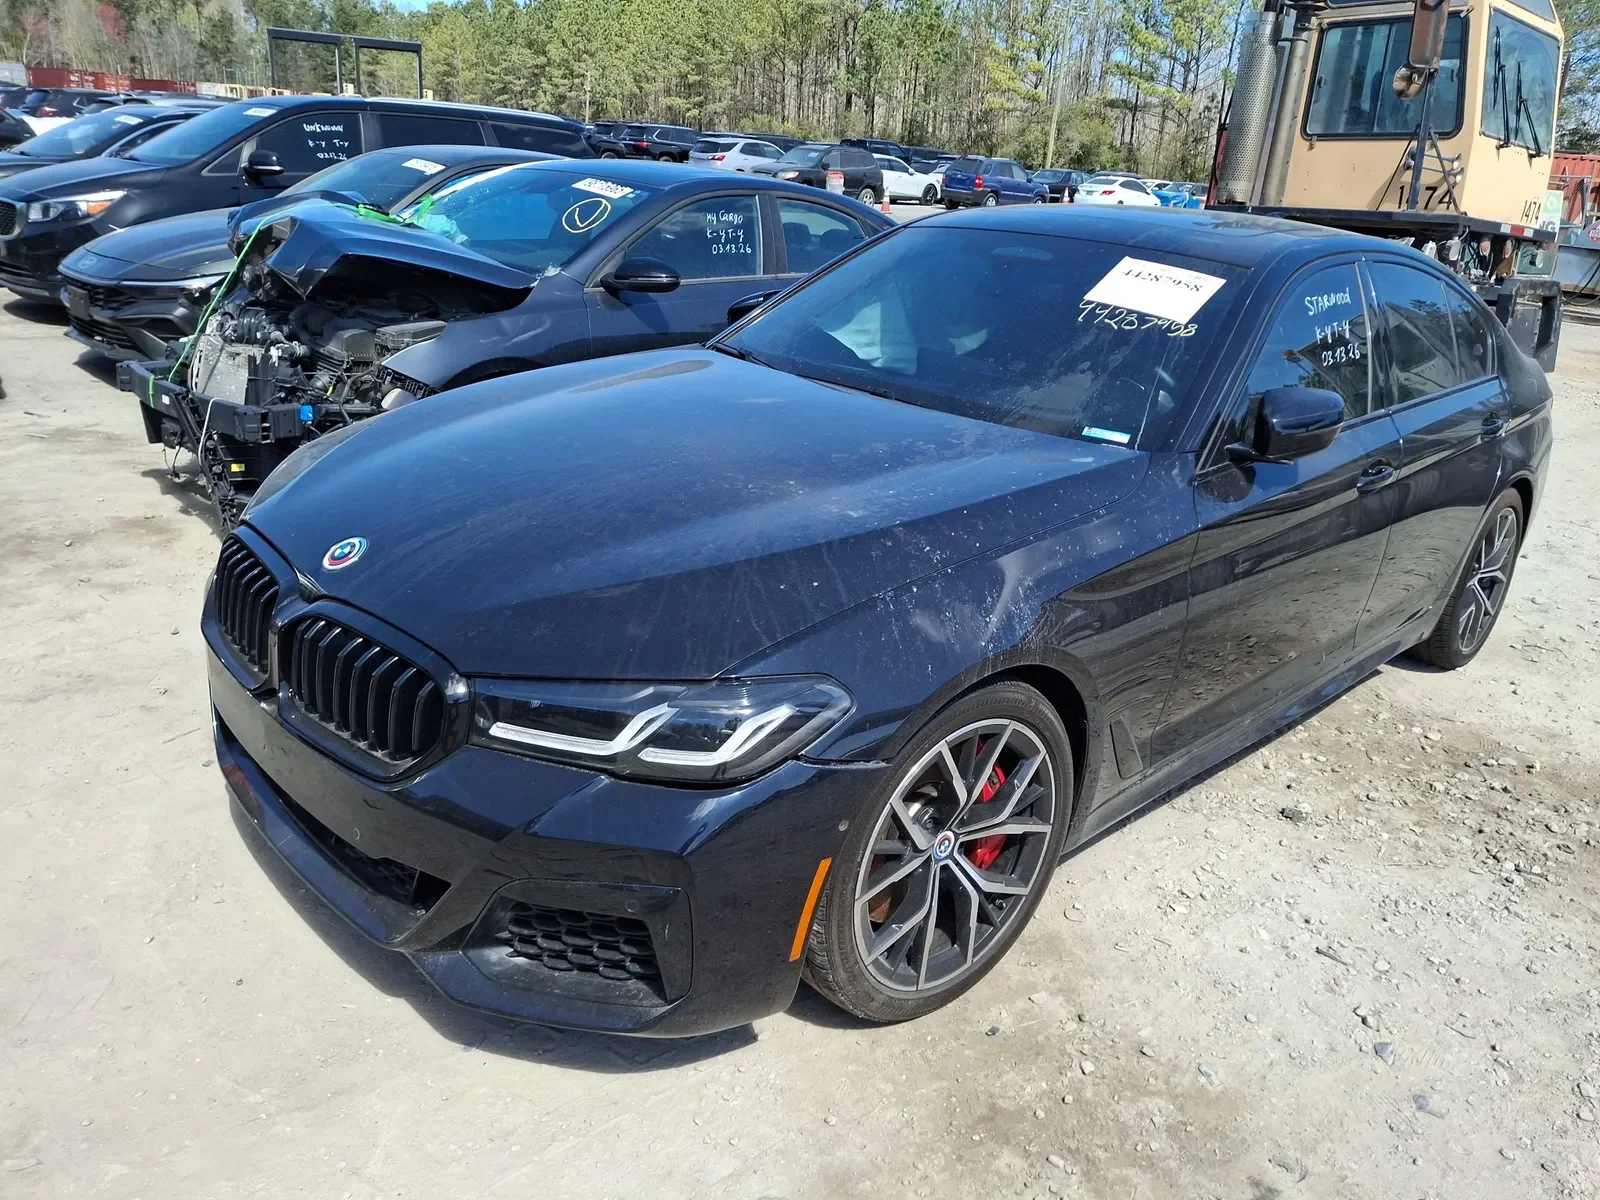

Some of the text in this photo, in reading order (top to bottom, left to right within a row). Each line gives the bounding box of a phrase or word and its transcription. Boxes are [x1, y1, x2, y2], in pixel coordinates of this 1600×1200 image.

[1397, 185, 1454, 210] 174
[1520, 200, 1541, 225] 1474
[712, 243, 752, 254] 03.13.26
[1322, 343, 1361, 367] 03.13.26
